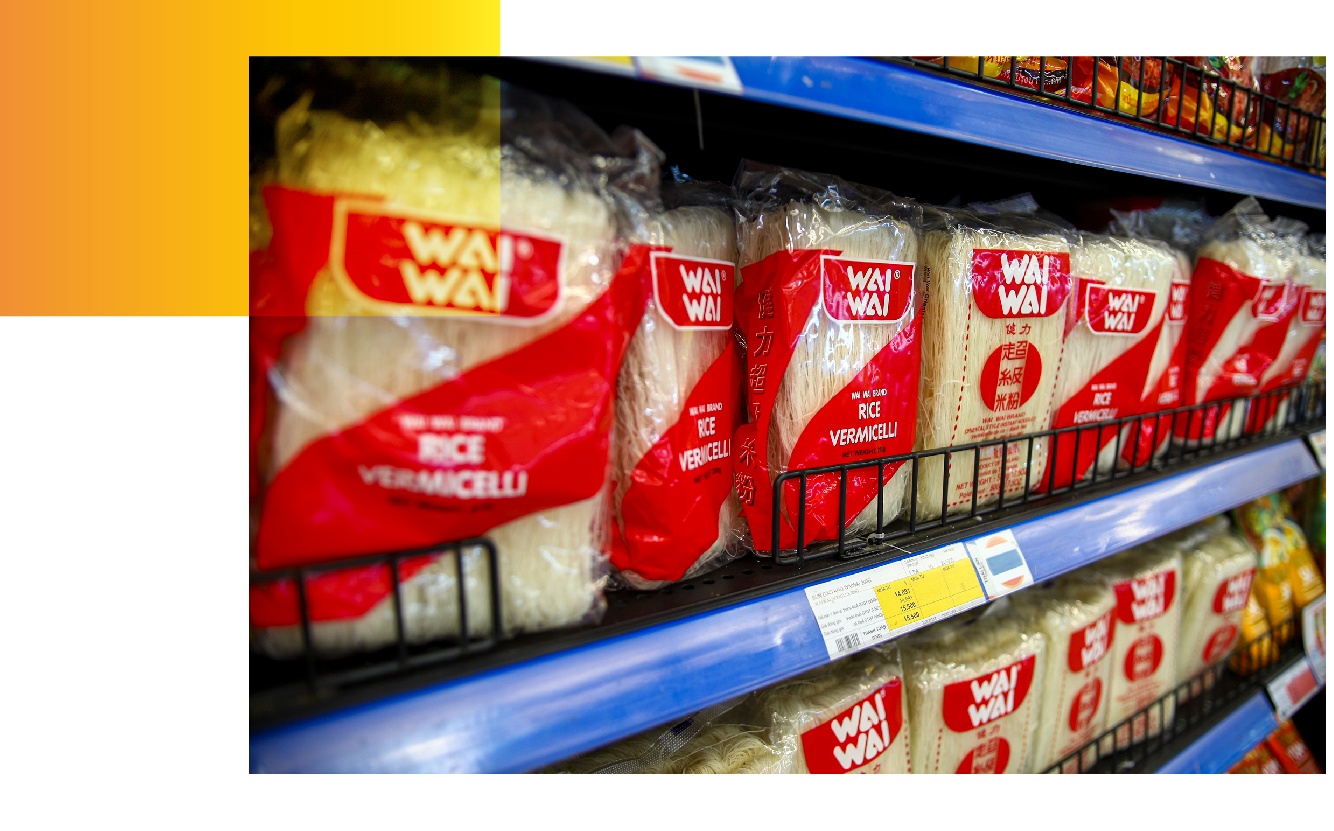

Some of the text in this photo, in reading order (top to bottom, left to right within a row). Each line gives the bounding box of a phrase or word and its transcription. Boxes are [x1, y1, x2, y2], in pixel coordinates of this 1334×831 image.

[402, 222, 513, 272] WAI
[679, 263, 721, 295] WAI
[846, 265, 892, 292] WAI
[1001, 253, 1050, 285] WAI
[400, 260, 510, 313] WAI
[998, 284, 1048, 316] WAI
[682, 293, 721, 323] WAI
[846, 291, 890, 317] WAI
[1109, 292, 1140, 313] WAI
[1104, 311, 1135, 332] WAI
[872, 388, 888, 398] BRAND
[1093, 392, 1112, 406] RICE
[858, 400, 881, 420] RICE
[697, 416, 716, 438] RICE
[829, 421, 898, 447] VERMICELLI
[418, 434, 486, 465] RICE
[679, 438, 731, 472] VERMICELLI
[357, 464, 528, 499] VERMICELLI
[956, 482, 968, 490] NET
[959, 490, 973, 499] Poid
[1131, 572, 1165, 600] WAI
[1130, 595, 1165, 622] WAI
[971, 666, 1017, 704] WAI
[831, 693, 886, 743] WAI
[968, 689, 1015, 727] WAI
[833, 720, 890, 769] WAI
